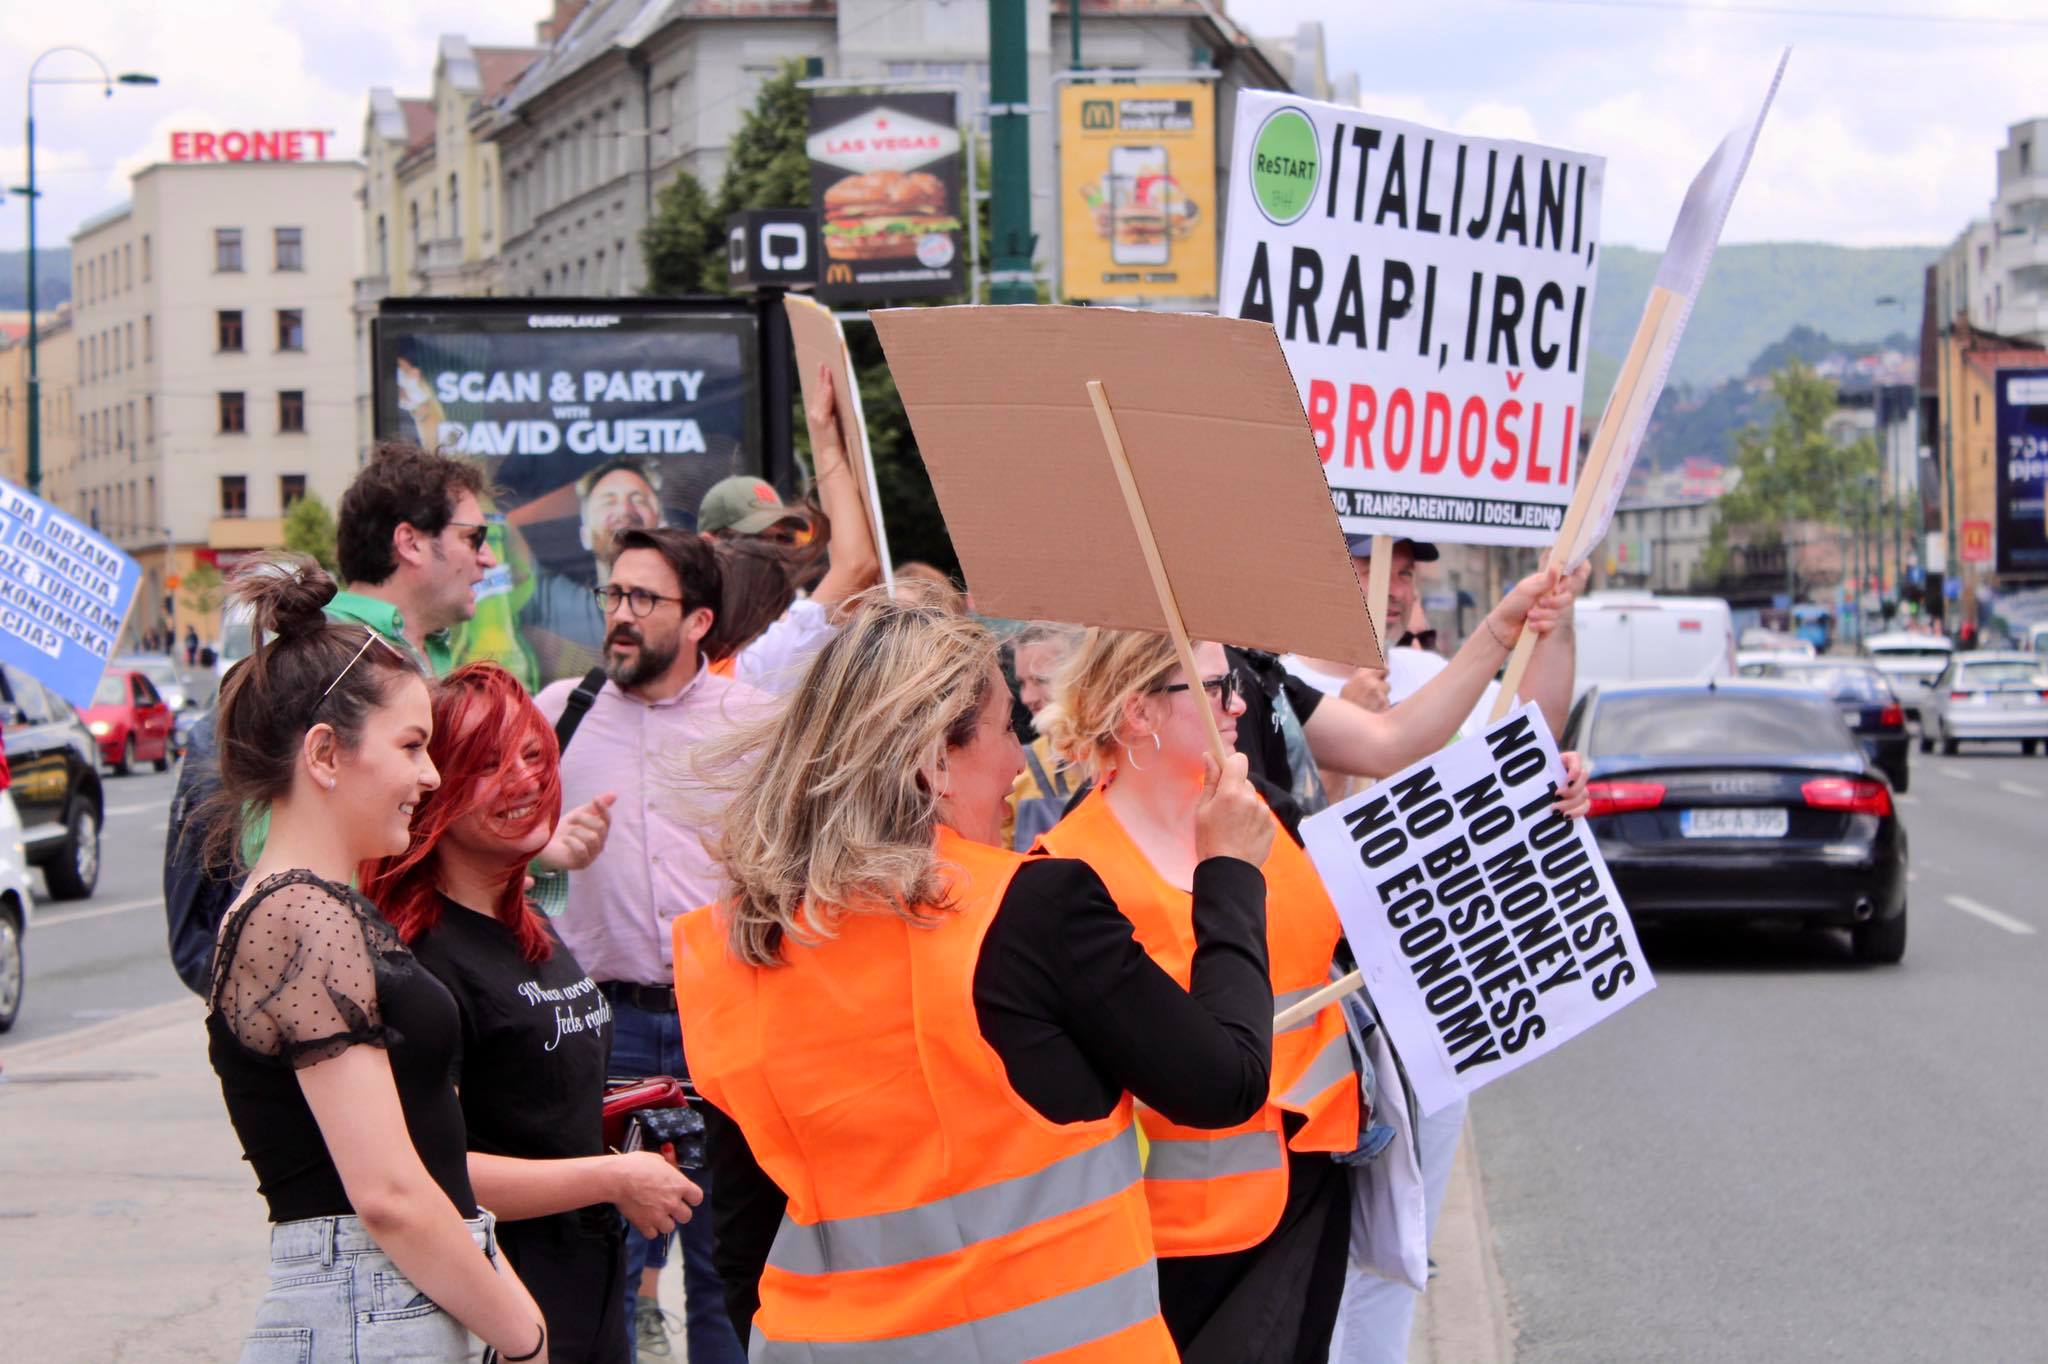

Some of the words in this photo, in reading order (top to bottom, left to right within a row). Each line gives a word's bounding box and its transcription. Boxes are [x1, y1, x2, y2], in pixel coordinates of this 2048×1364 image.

[171, 129, 333, 161] ERONET
[826, 139, 865, 154] LAS
[871, 136, 940, 150] VEGAS
[1257, 152, 1316, 181] ReSTART
[1326, 123, 1595, 270] ITALIJANI,
[1239, 241, 1449, 373] ARAPI,
[1464, 271, 1587, 373] IRCI
[436, 371, 541, 403] SCAN
[549, 371, 577, 403] &
[584, 371, 704, 402] PARTY
[553, 407, 590, 419] WITH
[437, 420, 560, 455] DAVID
[566, 420, 707, 454] GUETTA
[10, 498, 35, 523] DA
[48, 520, 119, 577] DRŽAVA
[1355, 492, 1475, 522] TRANSPARENTNO
[1476, 507, 1482, 521] I
[1484, 507, 1562, 530] DOSLJEDNO
[37, 572, 120, 633] TURIZAM
[1452, 773, 1516, 846] NO
[1485, 714, 1547, 788] NO
[1517, 780, 1636, 1001] TOURISTS
[1343, 795, 1408, 869] NO
[1376, 863, 1502, 1074] ECONOMY
[1389, 765, 1454, 840] NO
[1422, 835, 1546, 1055] BUSINESS
[1483, 840, 1582, 995] MONEY
[518, 981, 564, 1006] When
[562, 976, 604, 1000] wron
[544, 1005, 585, 1051] feels
[585, 995, 613, 1037] right
